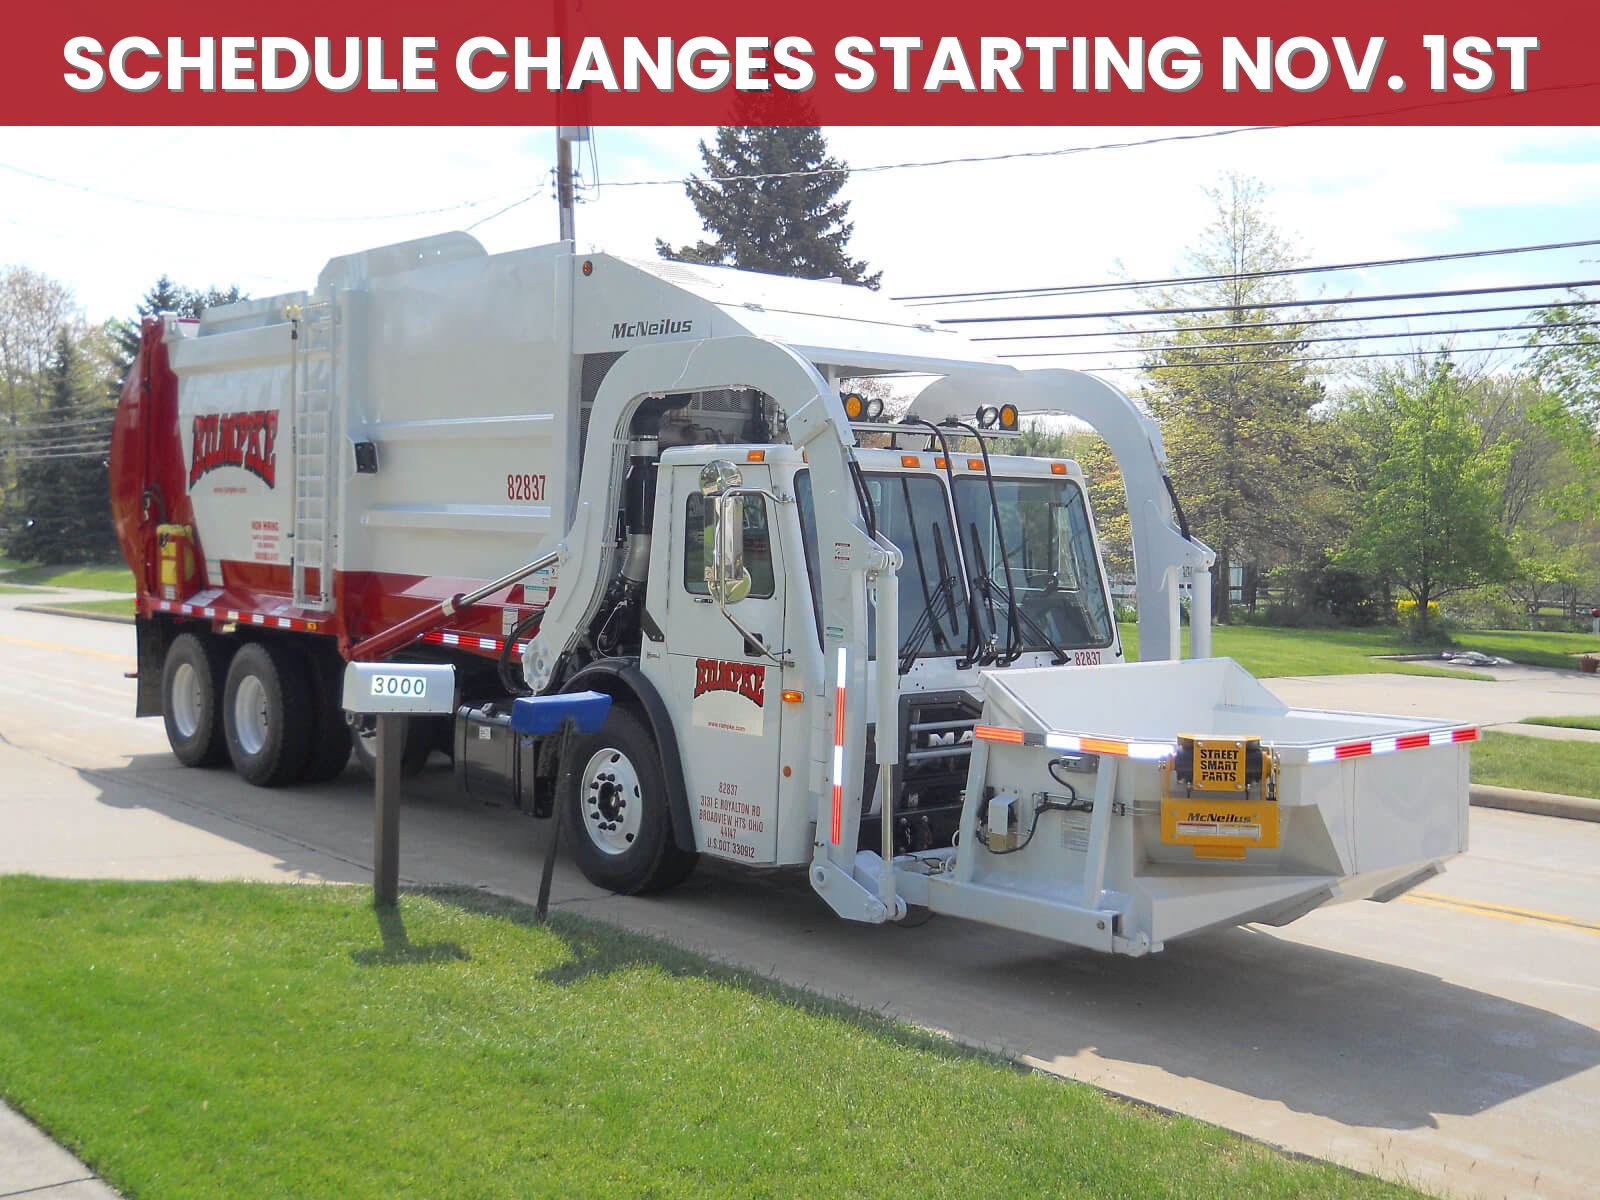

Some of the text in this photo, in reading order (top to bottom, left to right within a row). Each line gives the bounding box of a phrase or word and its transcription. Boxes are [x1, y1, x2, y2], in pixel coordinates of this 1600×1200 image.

[612, 319, 692, 339] McNeilus
[507, 475, 546, 501] 82837
[1075, 651, 1101, 666] 82837
[373, 677, 425, 695] 3000
[928, 730, 973, 747] MA
[1200, 749, 1239, 760] STREET
[1200, 761, 1238, 771] SMART
[1202, 771, 1236, 782] PARTS
[700, 795, 761, 817] 3131 E ROYALTON RD
[699, 809, 764, 833] BROADVIEW HTS OHIO
[1187, 812, 1251, 823] McNeilus
[732, 842, 755, 858] 330912
